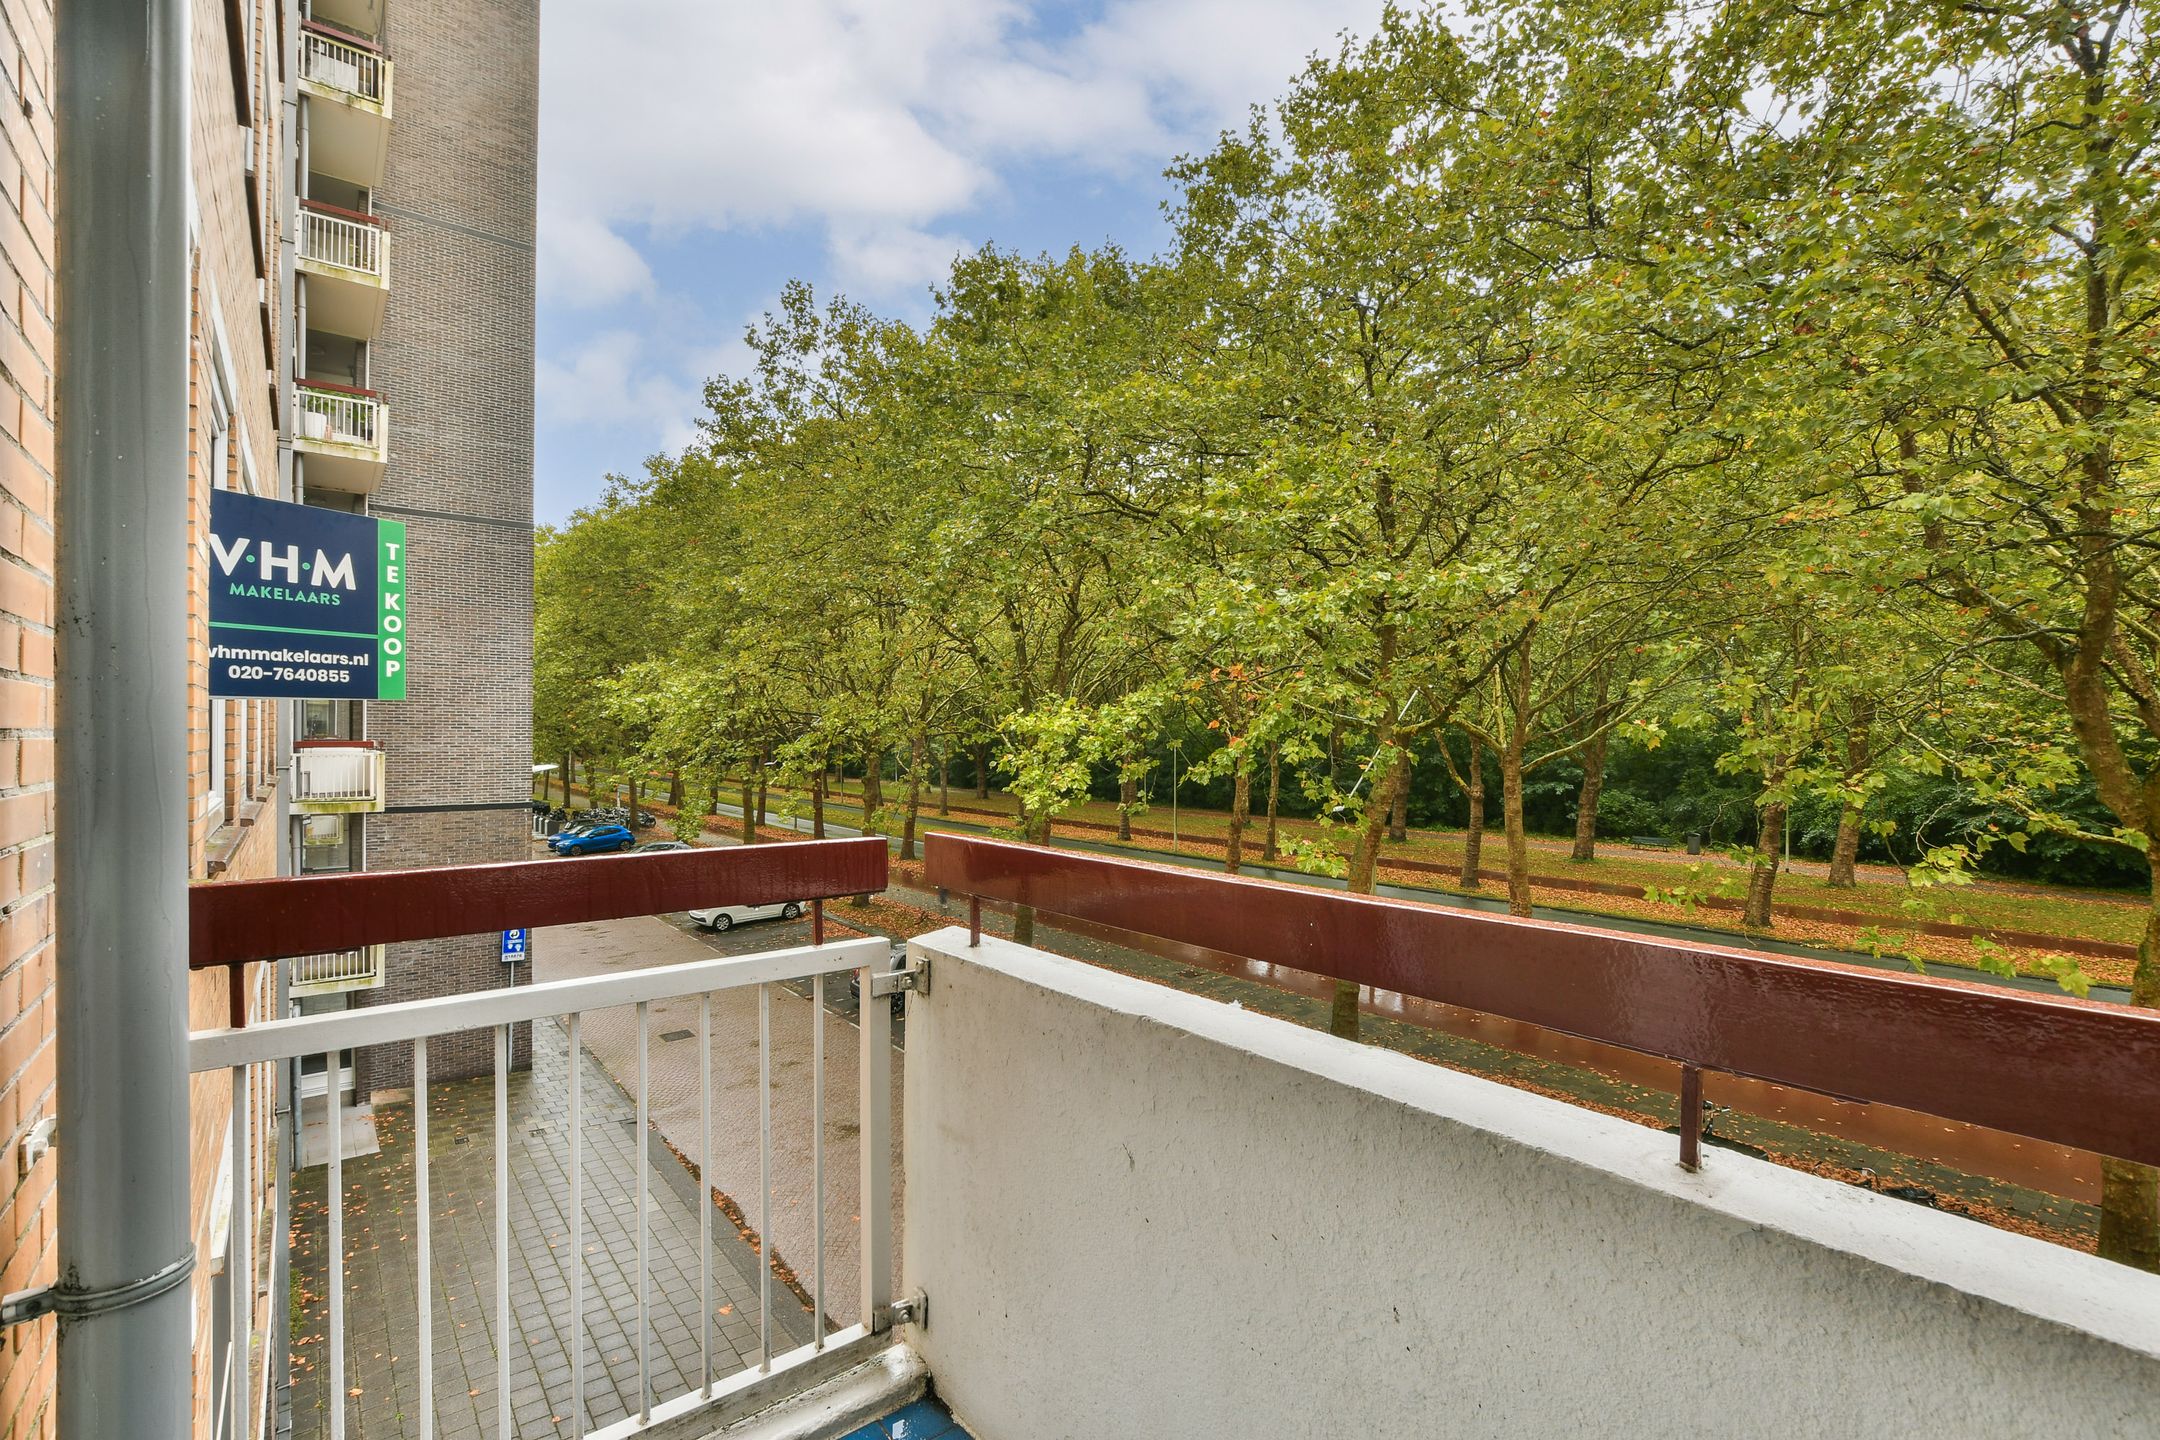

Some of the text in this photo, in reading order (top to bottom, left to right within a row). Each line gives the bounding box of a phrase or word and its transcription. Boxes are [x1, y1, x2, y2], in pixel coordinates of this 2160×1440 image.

[229, 582, 341, 605] MAKELAARS
[383, 542, 402, 677] TE KOOP
[208, 645, 369, 666] vhmmakelaars.nl
[228, 665, 350, 683] 020-7640855
